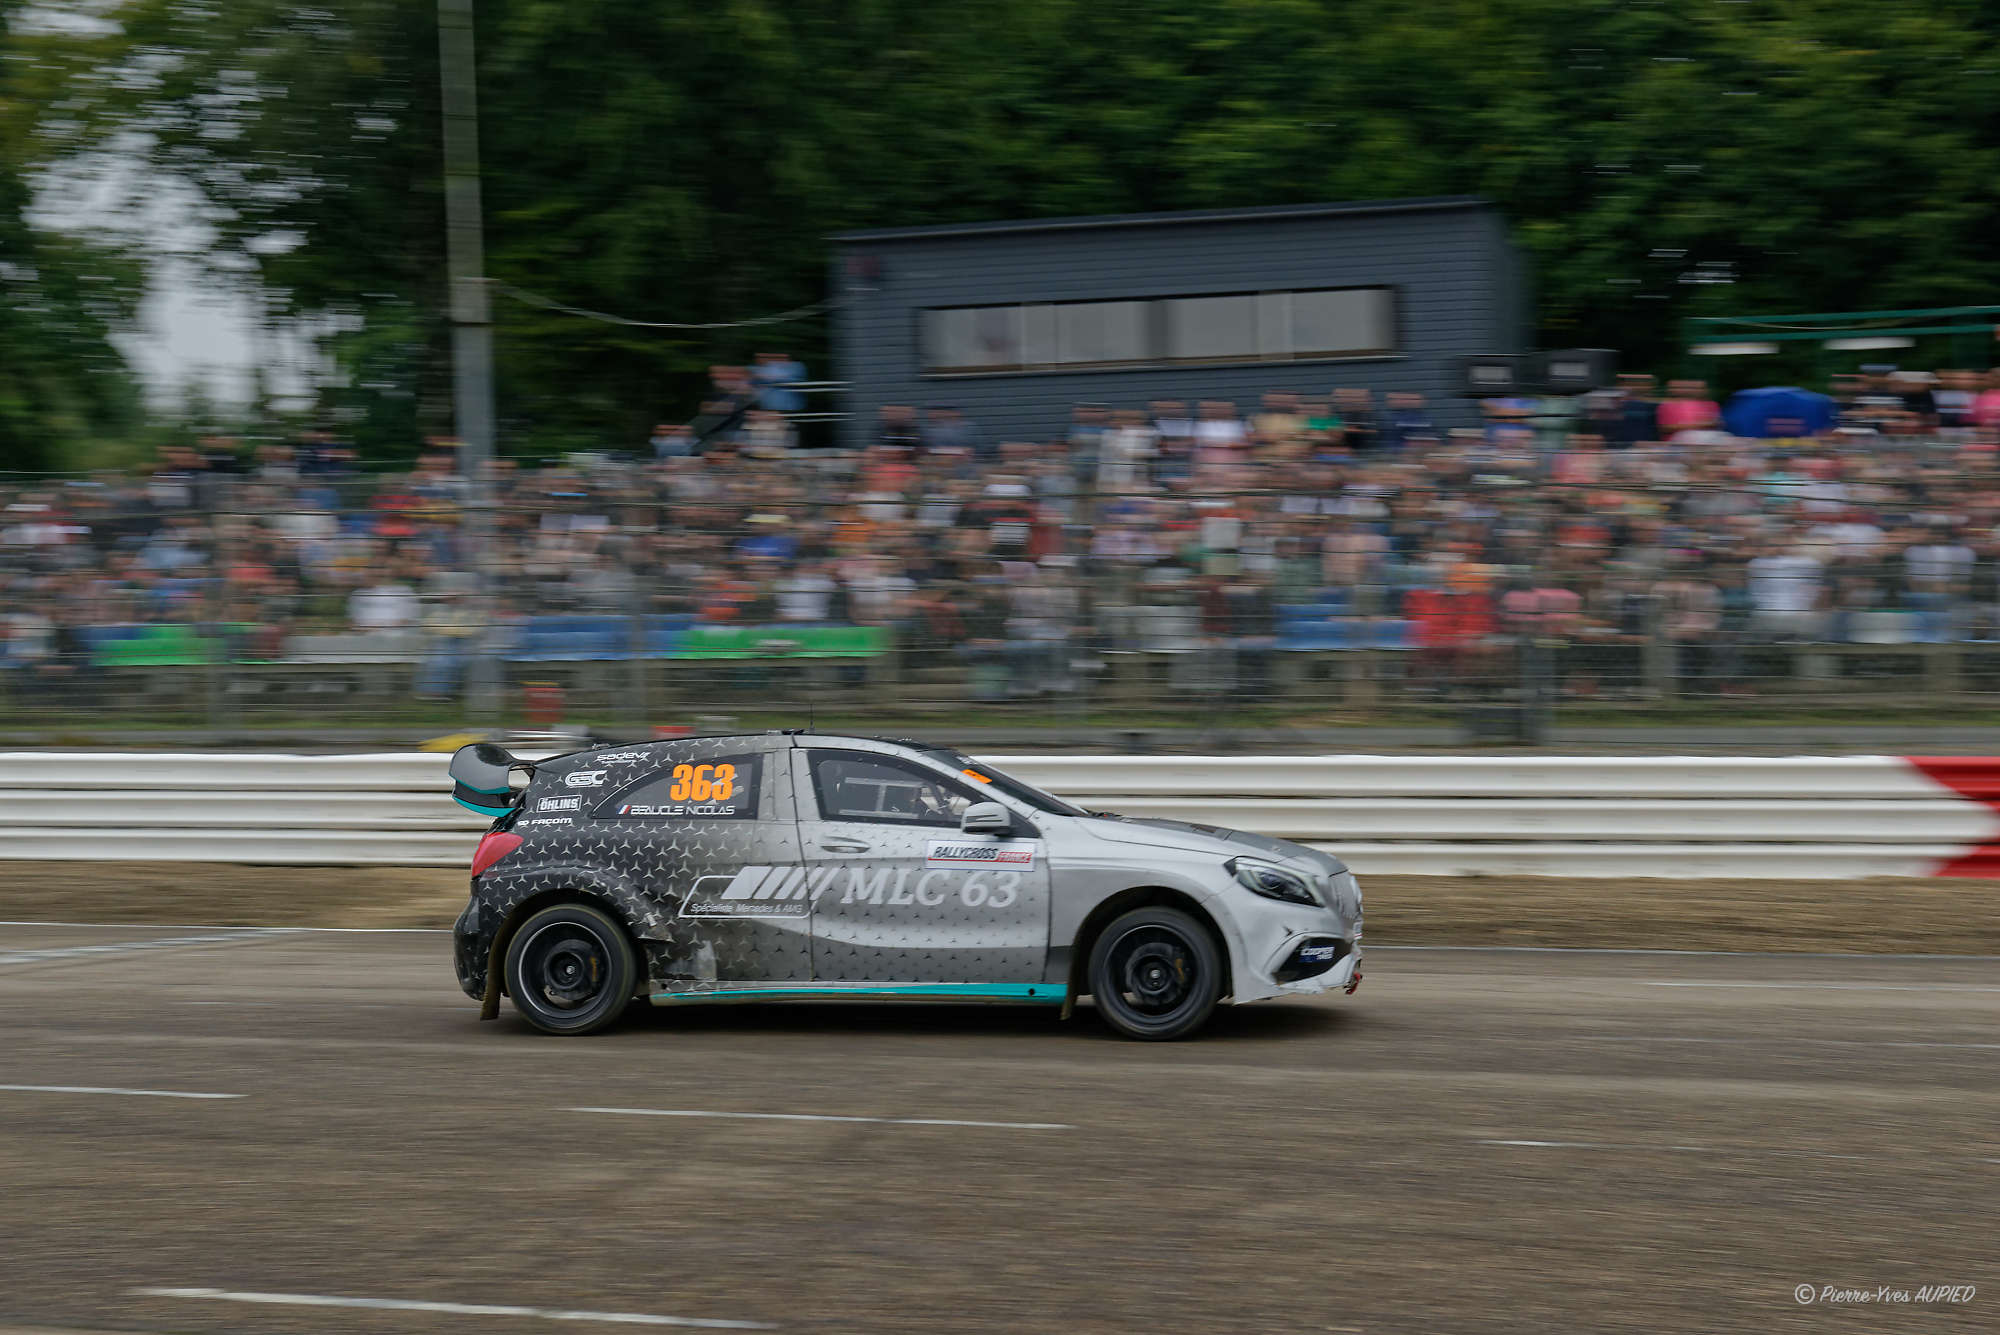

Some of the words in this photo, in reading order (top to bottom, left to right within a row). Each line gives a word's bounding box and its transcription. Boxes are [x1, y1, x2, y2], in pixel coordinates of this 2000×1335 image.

[669, 763, 735, 802] 363
[540, 797, 580, 811] ÖHLINS
[685, 804, 737, 816] NICOLAS
[933, 846, 999, 859] RALLYCROSS
[840, 867, 952, 906] MLC
[960, 868, 1022, 908] 63
[690, 903, 733, 914] Spécialiste
[735, 903, 773, 913] Mercedes
[773, 903, 782, 913] &
[783, 903, 803, 913] AMG
